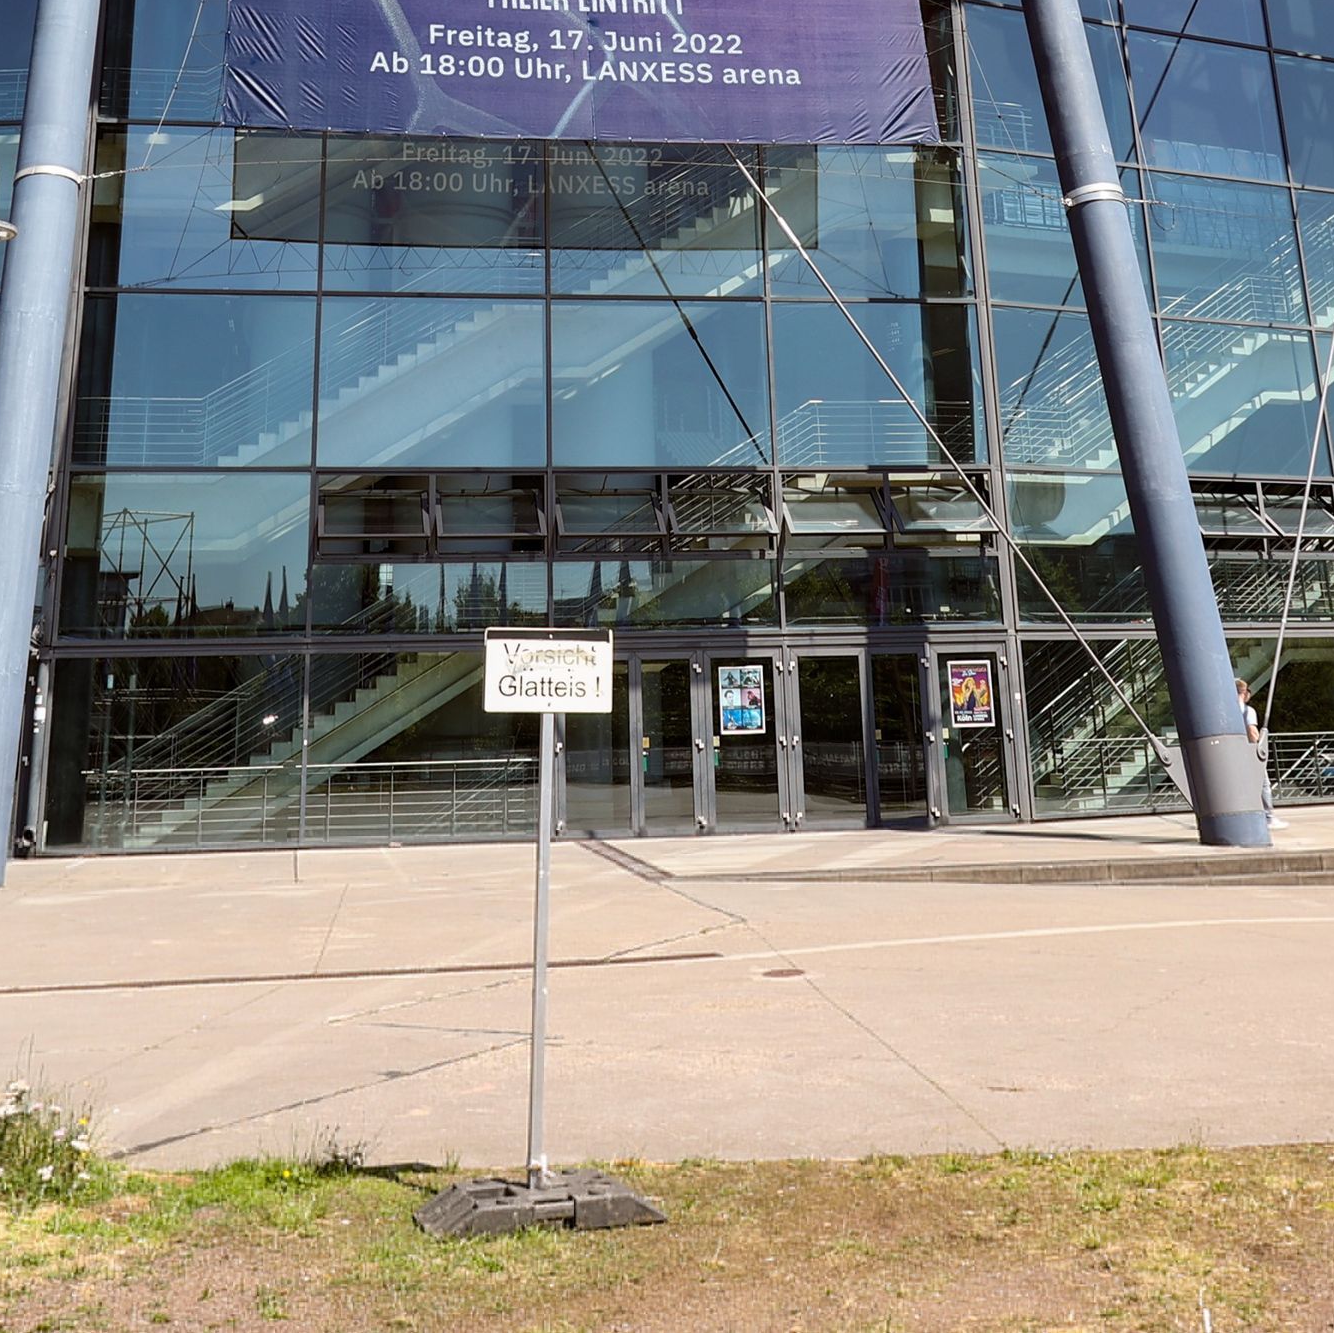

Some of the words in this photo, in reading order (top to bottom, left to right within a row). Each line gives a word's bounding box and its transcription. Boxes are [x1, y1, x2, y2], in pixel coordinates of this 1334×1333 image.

[428, 24, 539, 53] Freitag,
[550, 28, 594, 51] 17.
[603, 30, 665, 54] Juni
[673, 34, 743, 56] 2022
[370, 51, 409, 74] Ab
[420, 54, 505, 78] 18:00
[516, 57, 573, 83] Uhr,
[582, 60, 713, 84] LANXESS
[723, 66, 801, 86] arena
[498, 674, 587, 698] Glatteis
